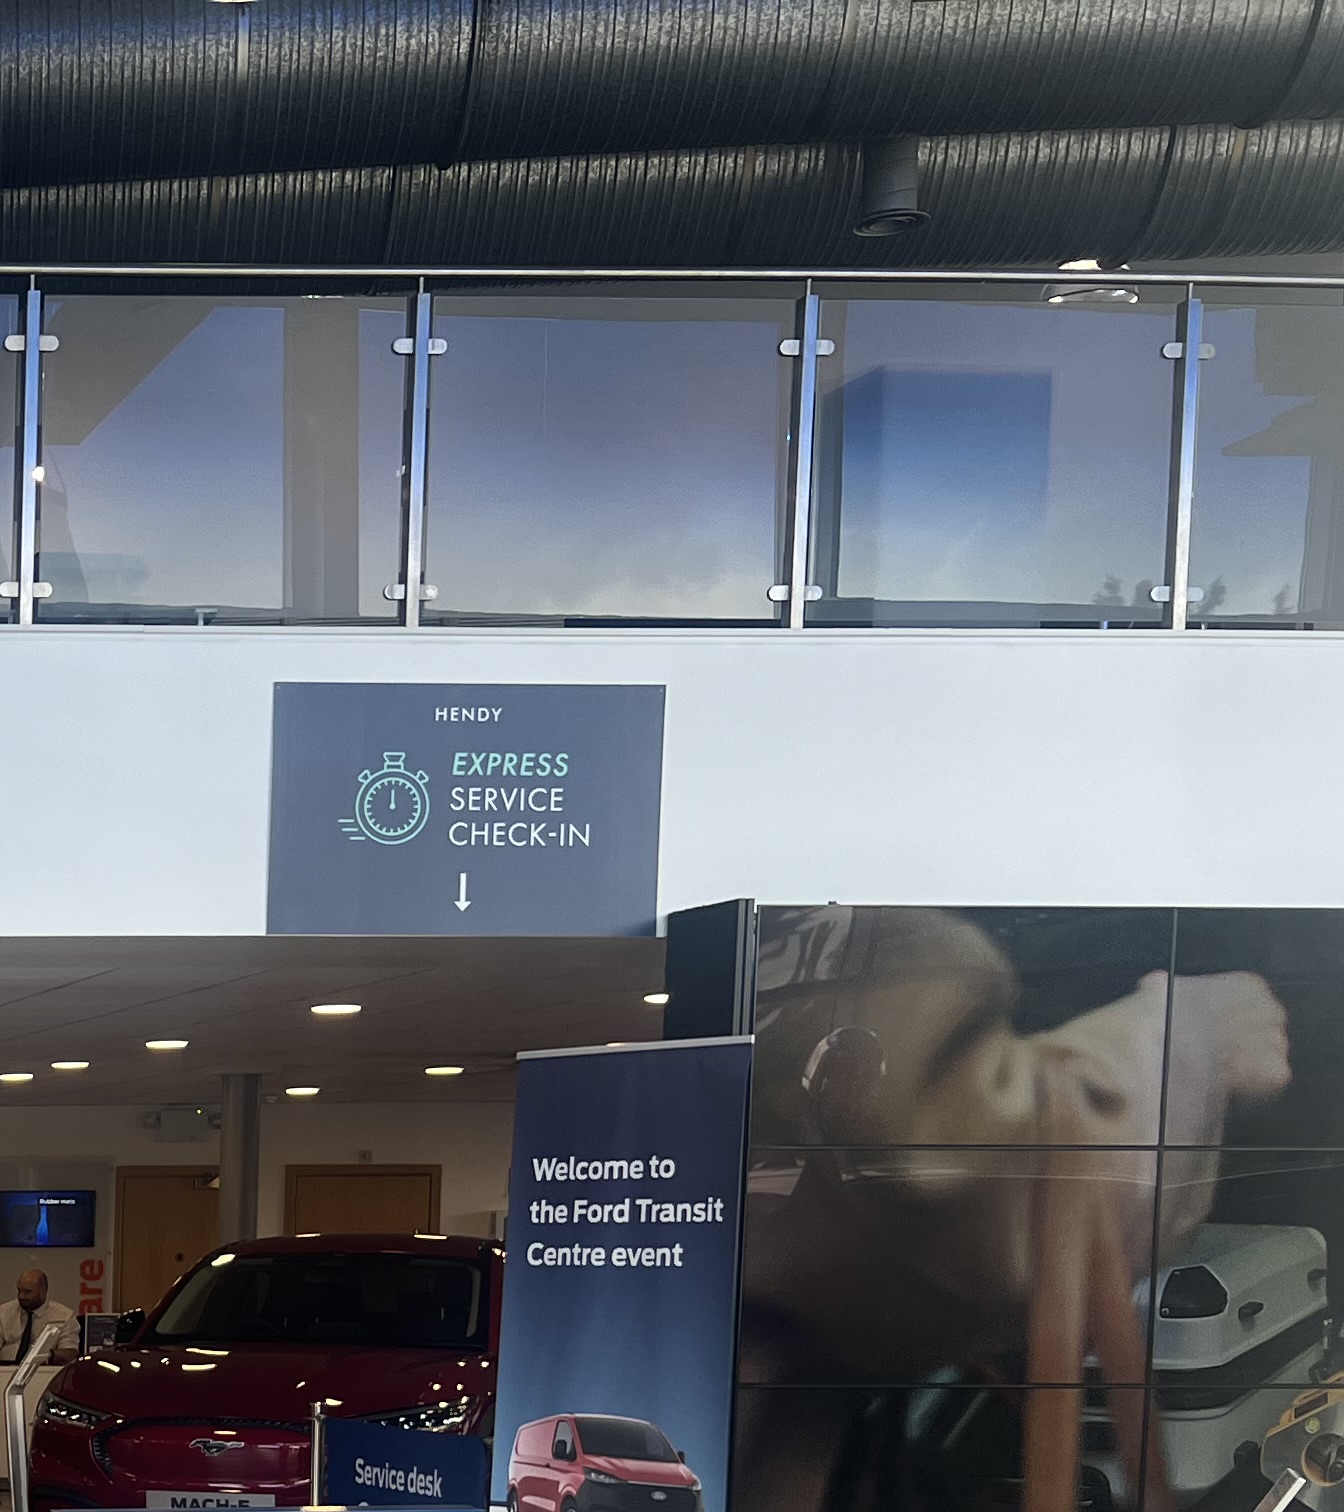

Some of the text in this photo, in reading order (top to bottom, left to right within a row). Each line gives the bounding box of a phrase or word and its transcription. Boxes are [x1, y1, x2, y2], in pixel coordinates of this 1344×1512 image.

[434, 707, 503, 723] HENDY
[452, 752, 569, 777] EXPRESS
[450, 787, 564, 812] SERVICE
[448, 822, 591, 848] CHECK-IN
[532, 1156, 675, 1182] Welcome to
[529, 1197, 723, 1224] the Ford Transit
[526, 1243, 683, 1267] Centre event
[355, 1458, 442, 1498] Service desk
